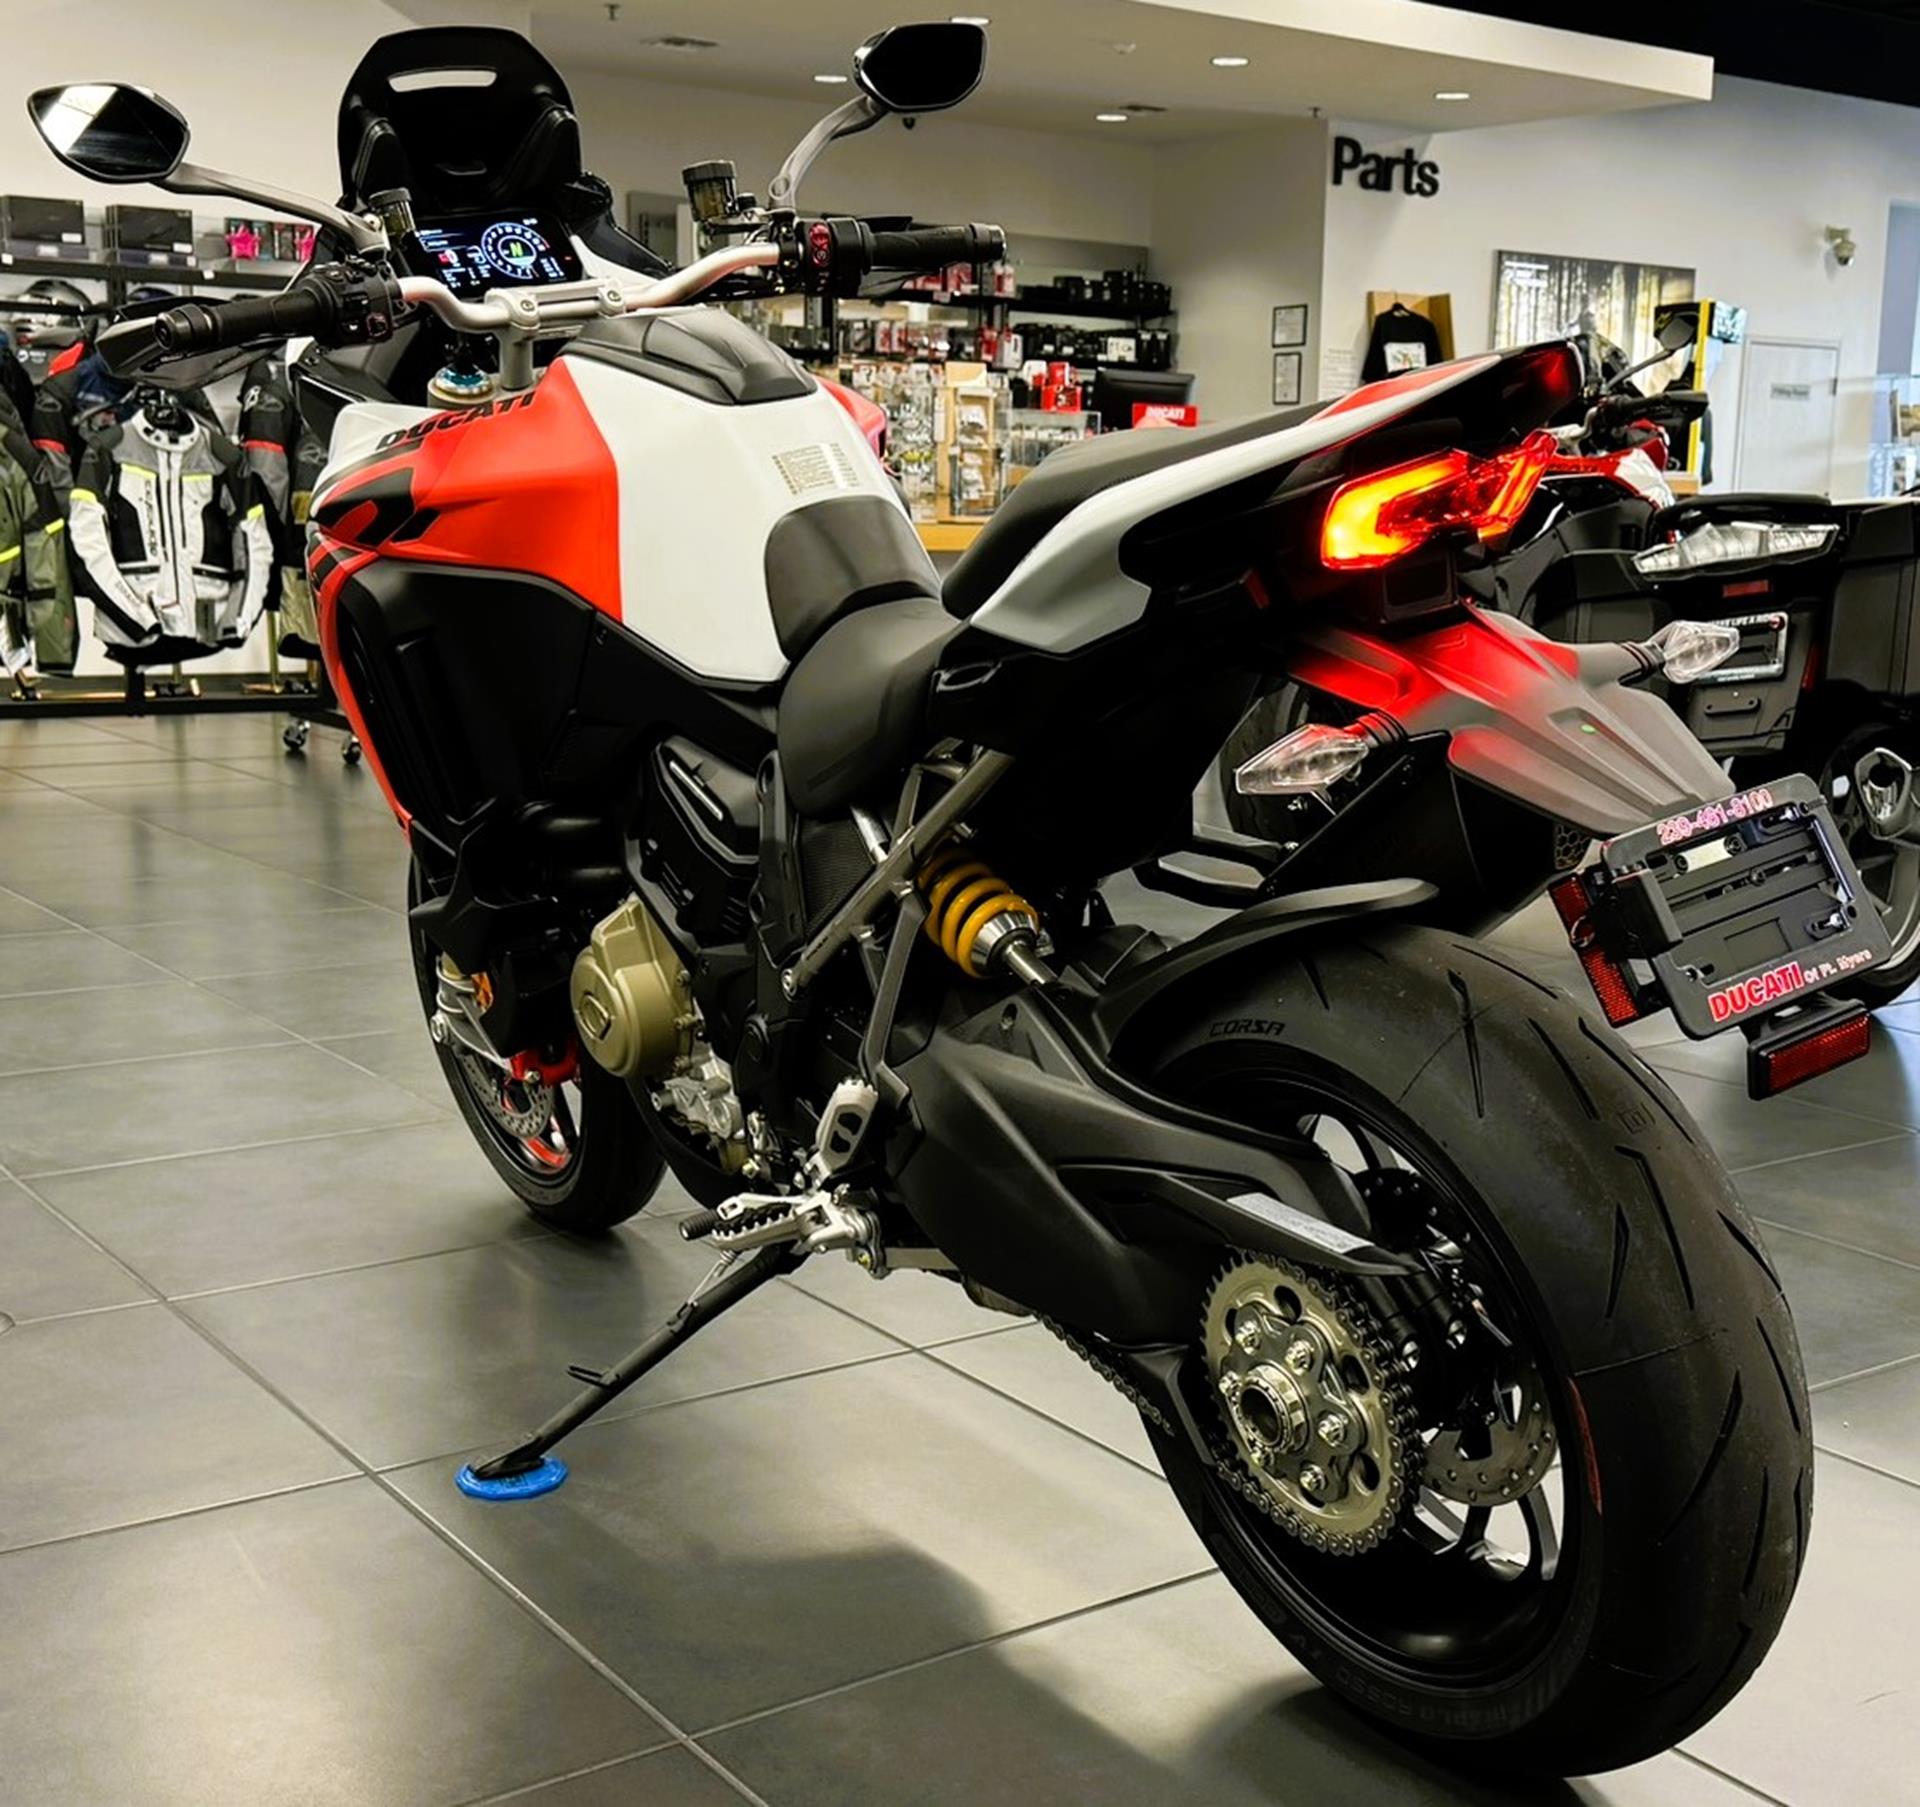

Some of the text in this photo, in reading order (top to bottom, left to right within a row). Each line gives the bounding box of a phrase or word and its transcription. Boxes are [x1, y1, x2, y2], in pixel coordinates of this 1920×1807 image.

[1332, 136, 1439, 198] Parts
[376, 391, 536, 451] DUCATI
[1708, 961, 1804, 1022] DUCATI
[1209, 1019, 1286, 1037] CORSA
